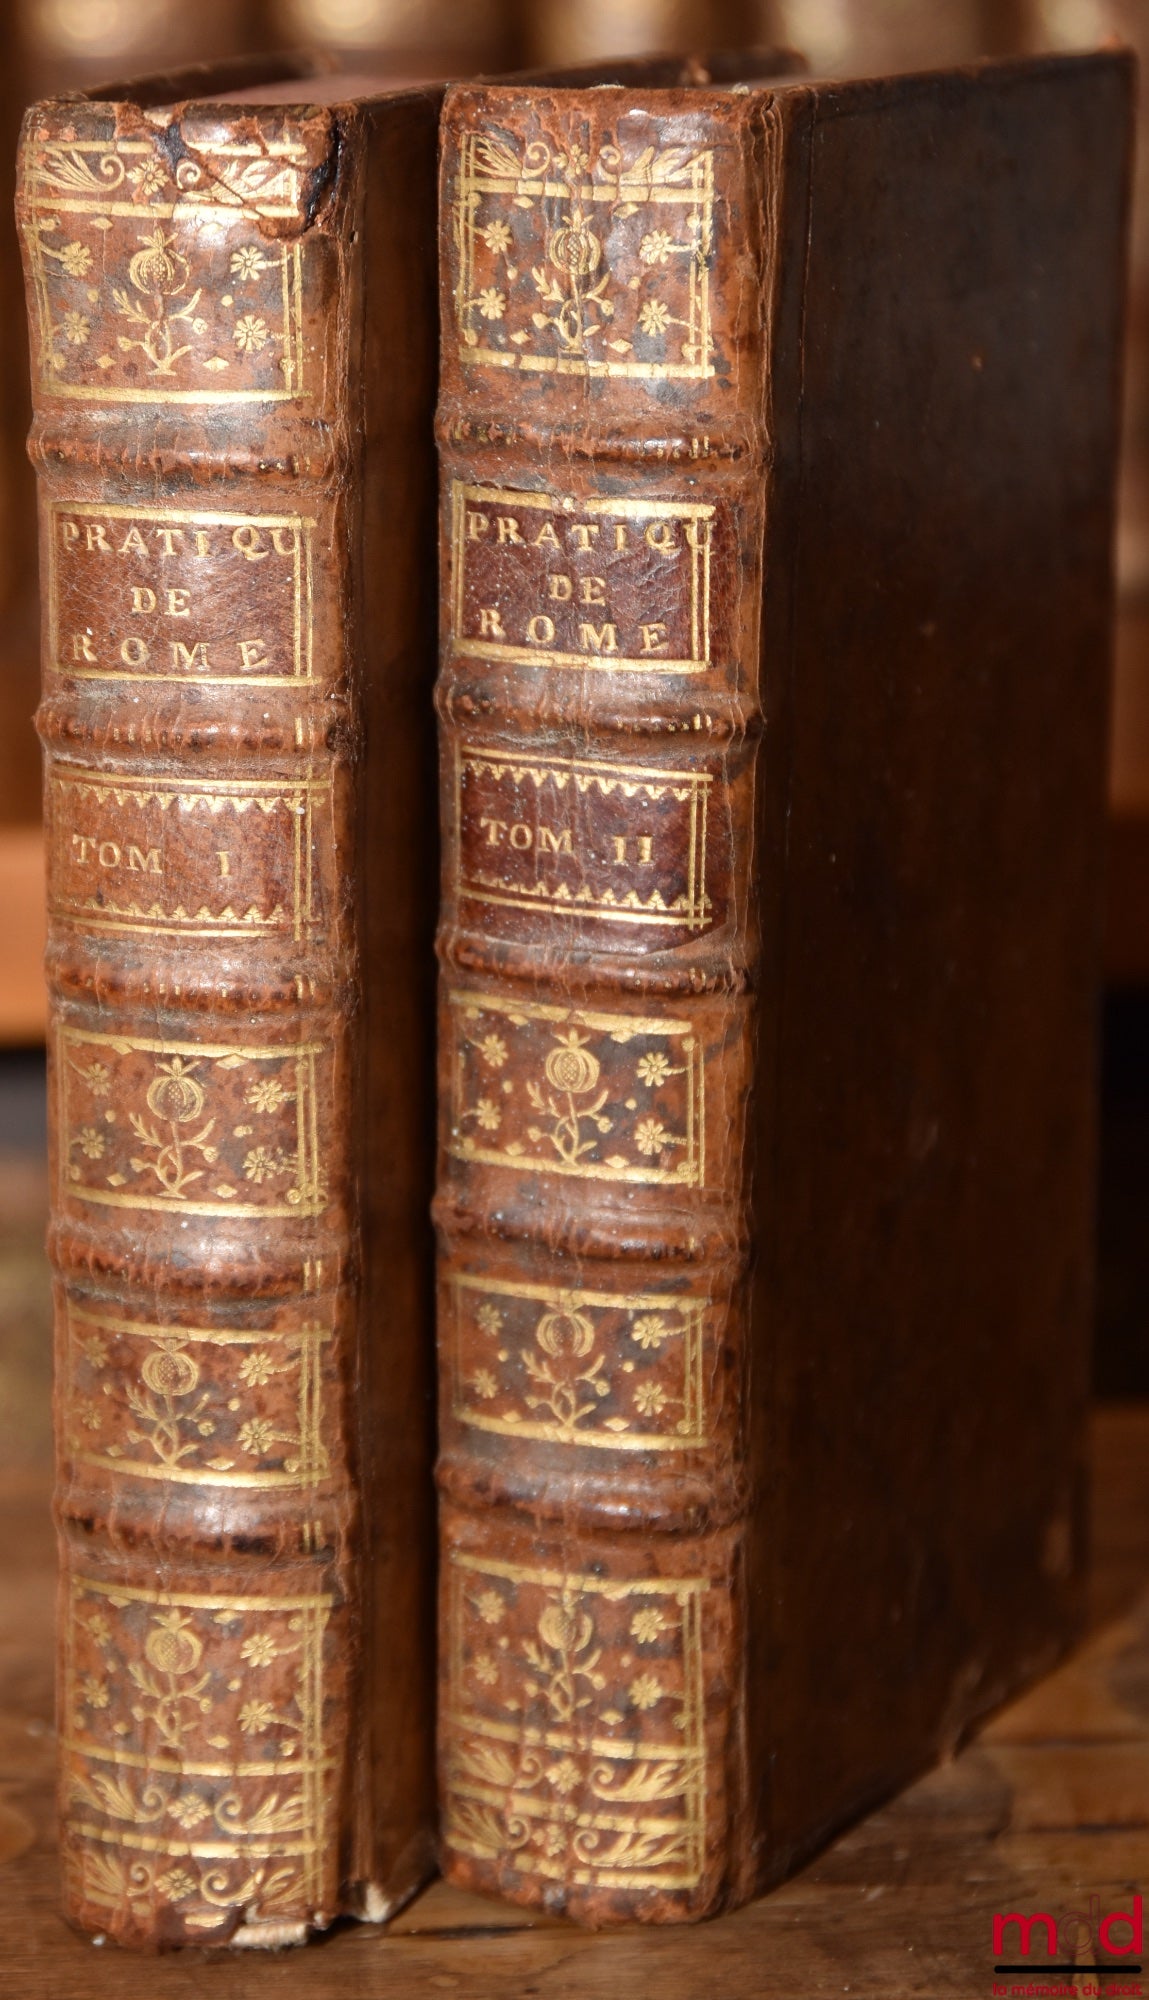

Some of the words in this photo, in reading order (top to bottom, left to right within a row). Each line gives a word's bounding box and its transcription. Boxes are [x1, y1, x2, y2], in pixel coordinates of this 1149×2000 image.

[131, 587, 190, 617] DE
[550, 574, 606, 606] DE
[480, 609, 669, 653] ROME
[72, 633, 269, 671] ROME
[72, 834, 163, 874] TOM
[216, 851, 231, 878] I
[480, 817, 572, 854] TOM
[611, 836, 653, 866] II
